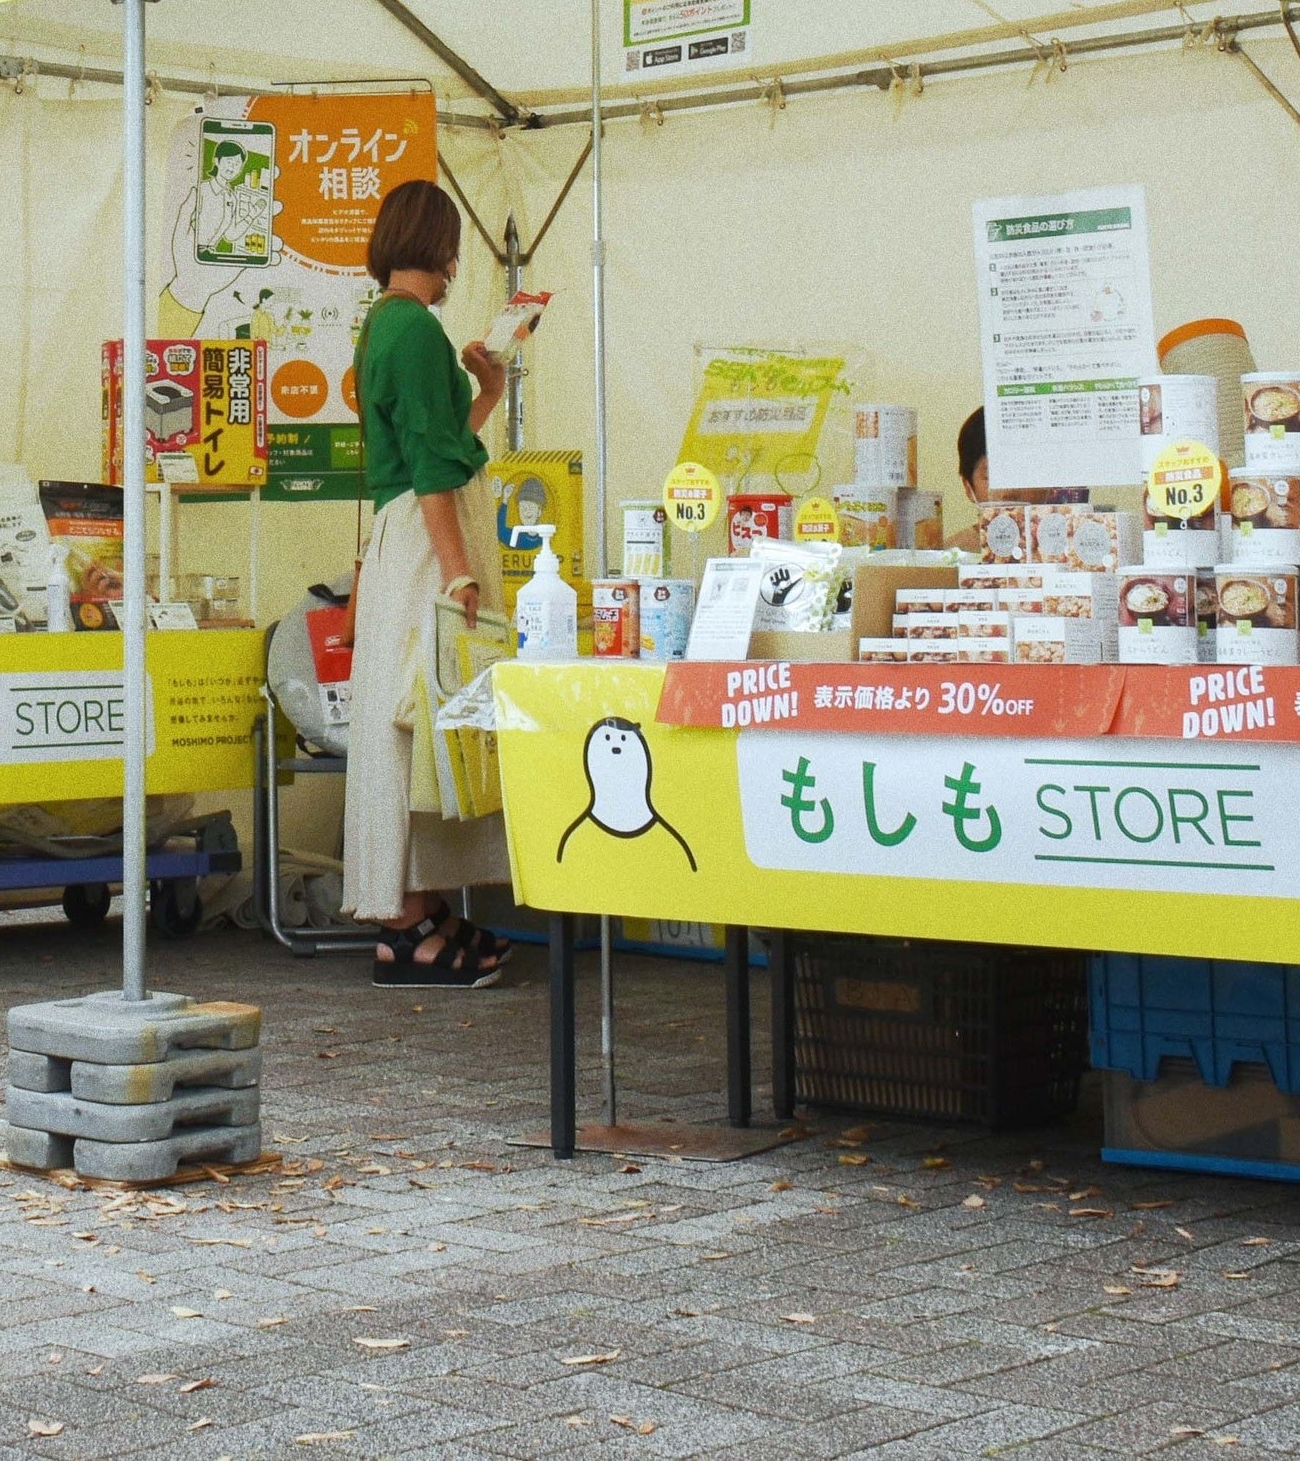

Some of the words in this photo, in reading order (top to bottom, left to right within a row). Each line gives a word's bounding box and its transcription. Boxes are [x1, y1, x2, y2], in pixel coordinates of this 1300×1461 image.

[288, 127, 409, 164] オンライン
[318, 167, 383, 201] 相談
[227, 347, 252, 425] 非常用
[203, 347, 226, 476] 簡易トイレ
[676, 502, 706, 520] No.3
[1165, 483, 1204, 506] No.3
[726, 661, 792, 698] PRICE
[813, 685, 931, 711] 表示価格より
[1188, 665, 1266, 705] PRICE
[15, 698, 125, 737] STORE
[721, 691, 799, 728] DOWN!
[1181, 697, 1276, 739] DOWN!
[172, 736, 214, 748] MOSHIMO
[779, 755, 1004, 852] もしも
[1035, 783, 1263, 848] STORE
